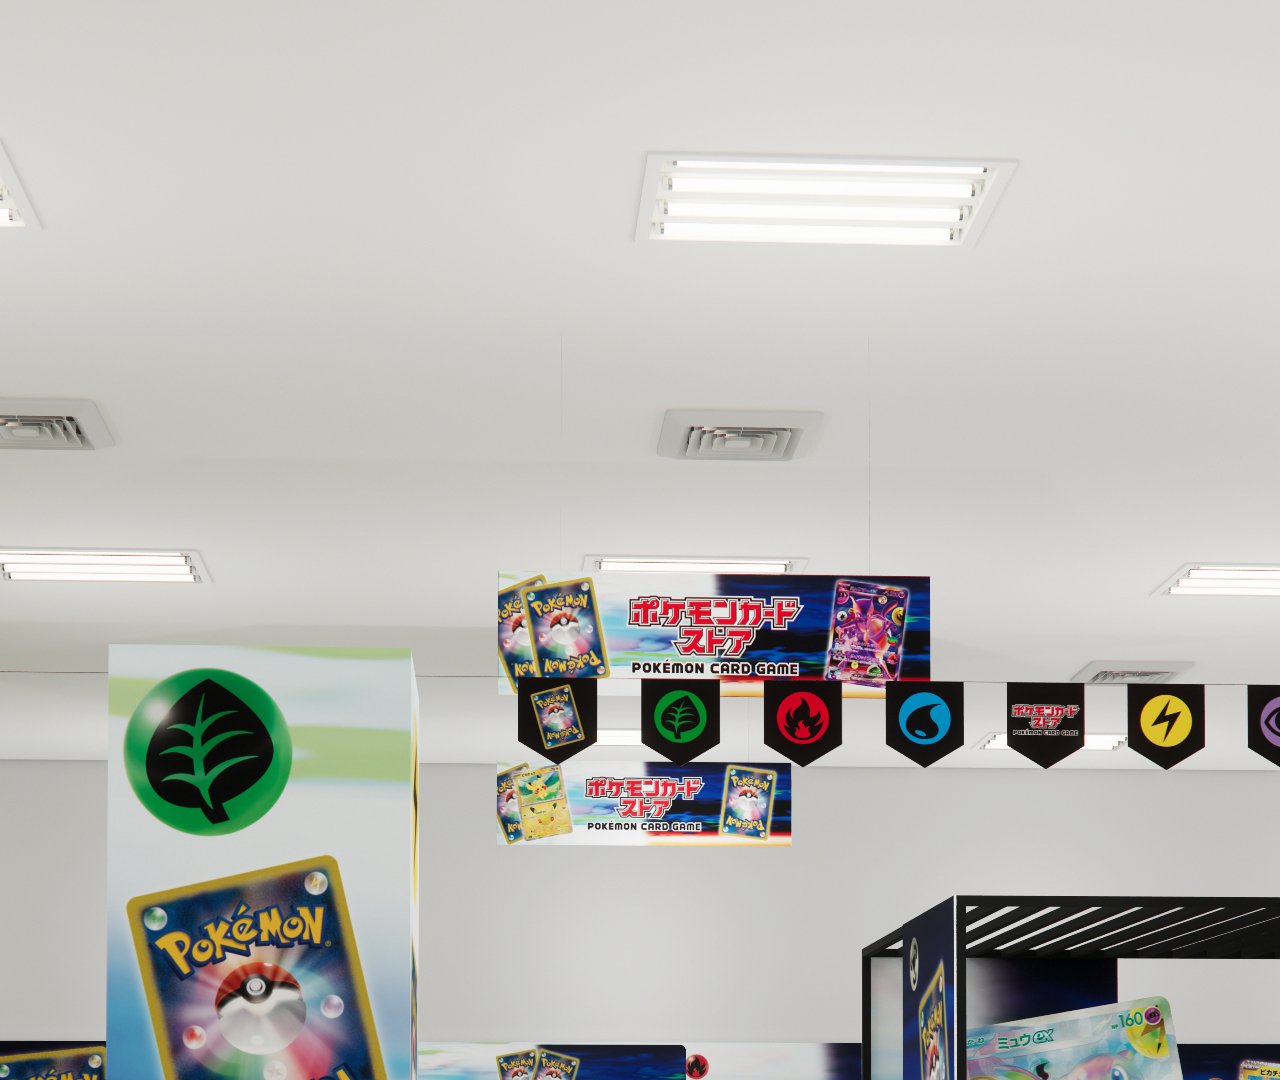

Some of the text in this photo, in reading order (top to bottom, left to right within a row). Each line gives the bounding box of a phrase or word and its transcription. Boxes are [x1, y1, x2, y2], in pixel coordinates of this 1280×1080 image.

[627, 596, 805, 630] ポケモンカード
[671, 627, 760, 658] ストア
[710, 662, 752, 675] CARD
[756, 662, 800, 675] GAME
[584, 776, 705, 799] ポケモンカード
[616, 797, 674, 819] ストア
[640, 823, 669, 831] CARD
[672, 823, 701, 831] GAME
[155, 903, 325, 980] Pokémon
[1120, 1011, 1143, 1028] 160
